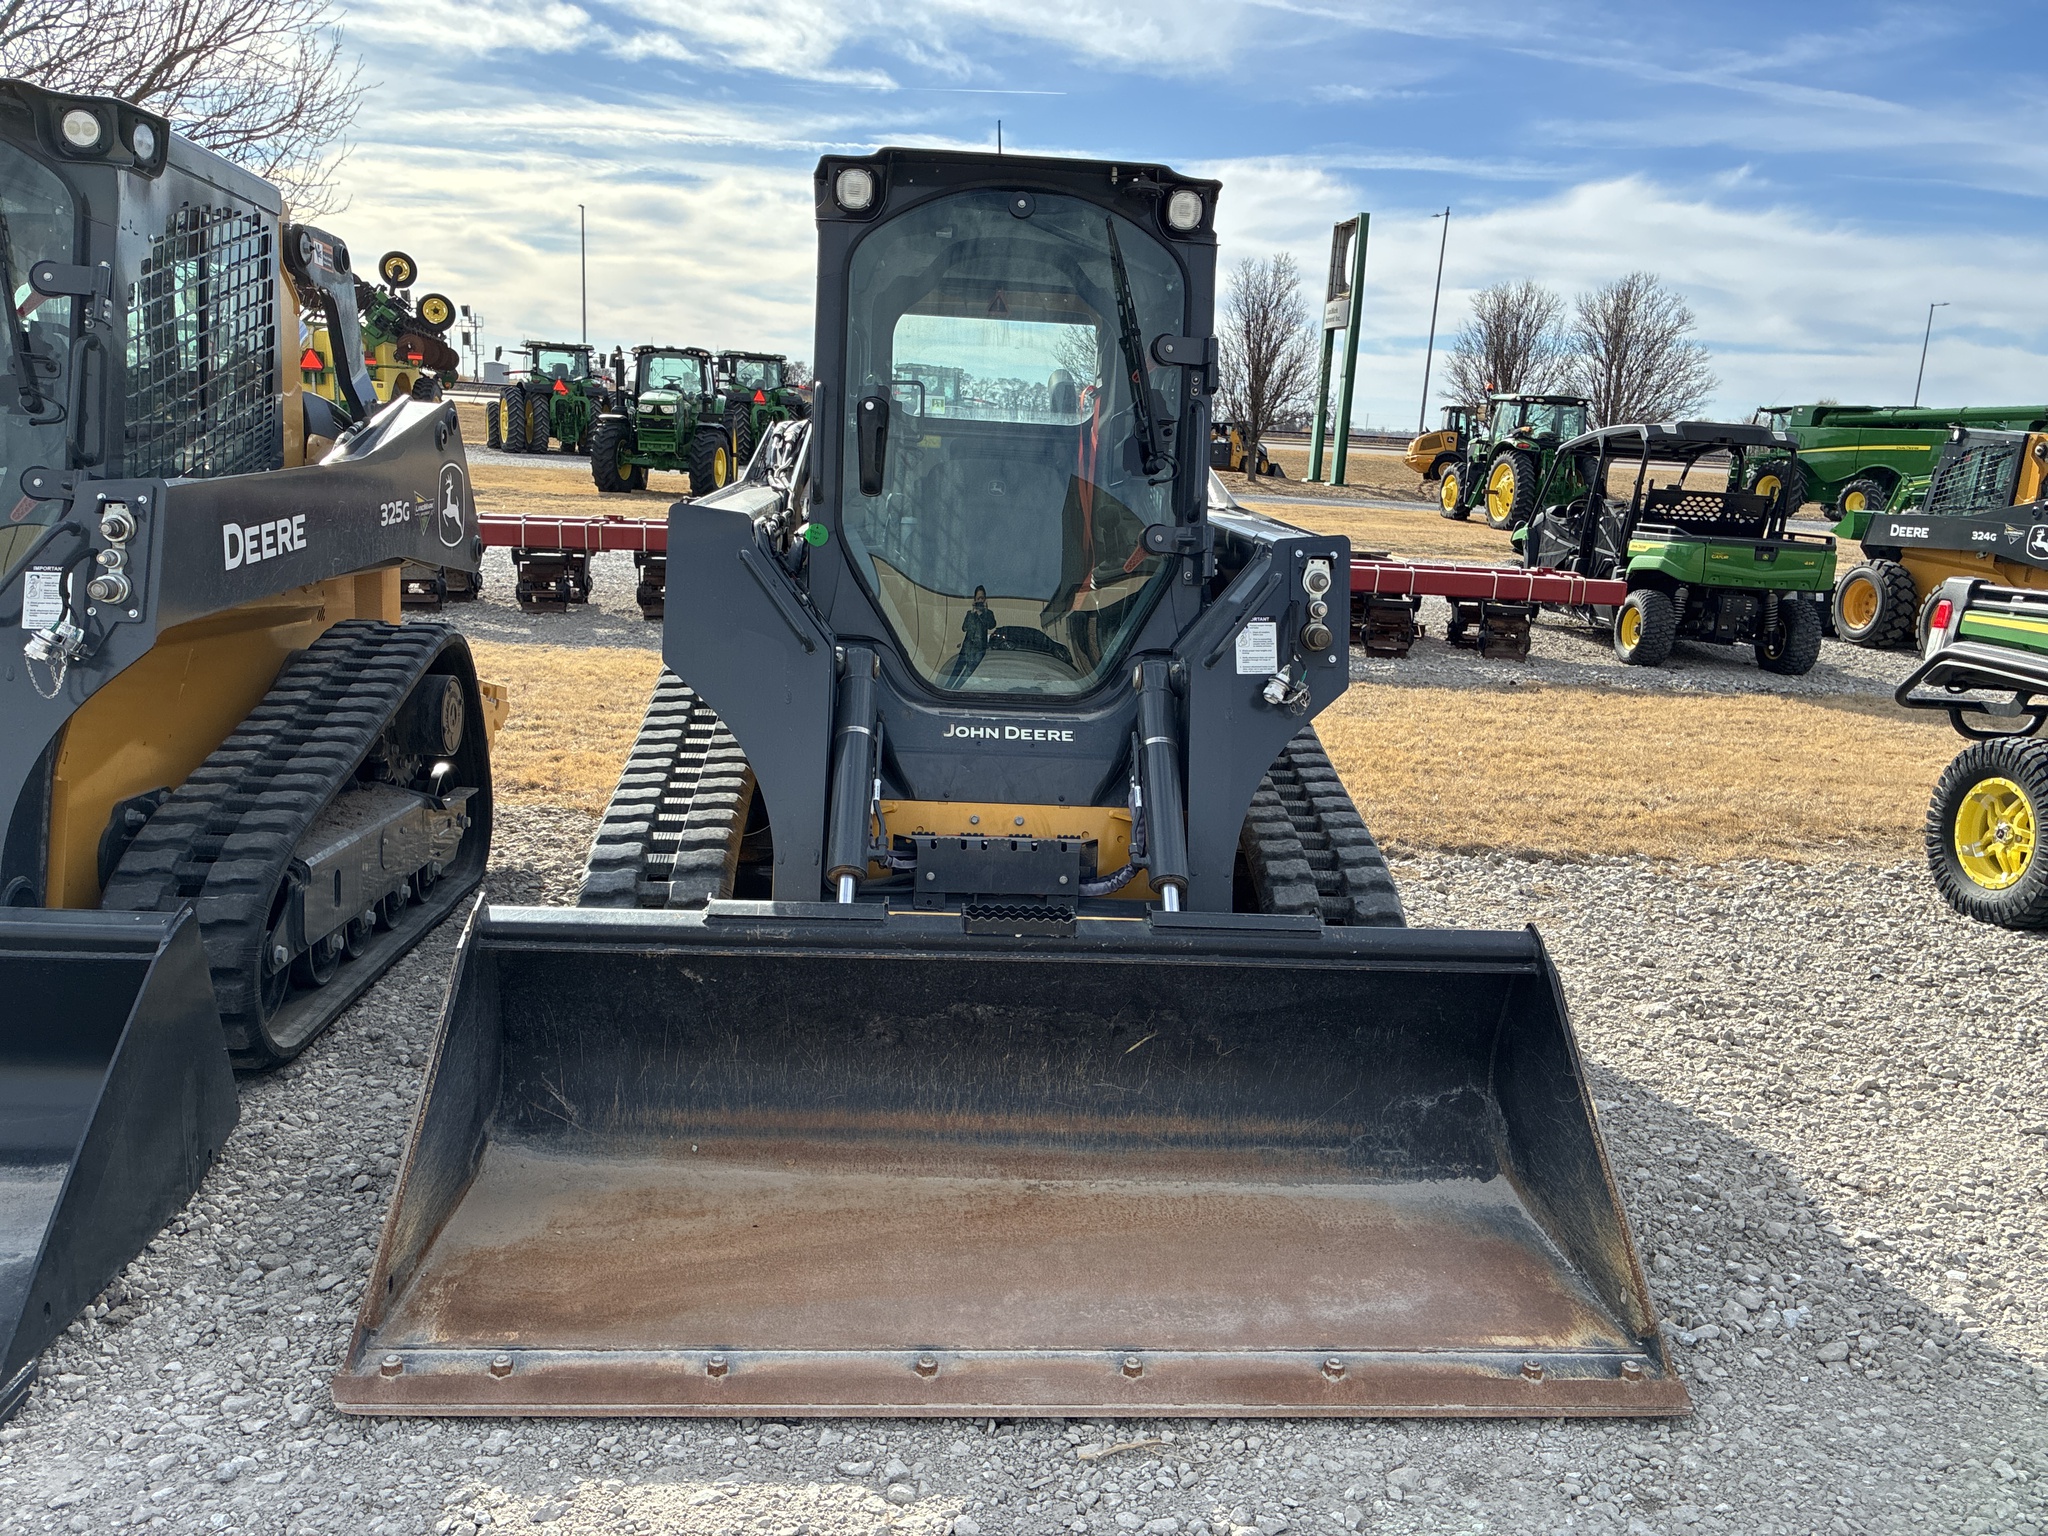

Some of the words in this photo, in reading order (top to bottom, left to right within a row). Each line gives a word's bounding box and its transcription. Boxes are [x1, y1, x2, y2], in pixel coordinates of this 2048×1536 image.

[380, 500, 410, 527] 325G
[1889, 523, 1930, 539] DEERE
[1971, 530, 1997, 542] 324G
[222, 513, 307, 571] DEERE
[943, 723, 999, 739] JOHN
[1004, 726, 1074, 742] DEERE
